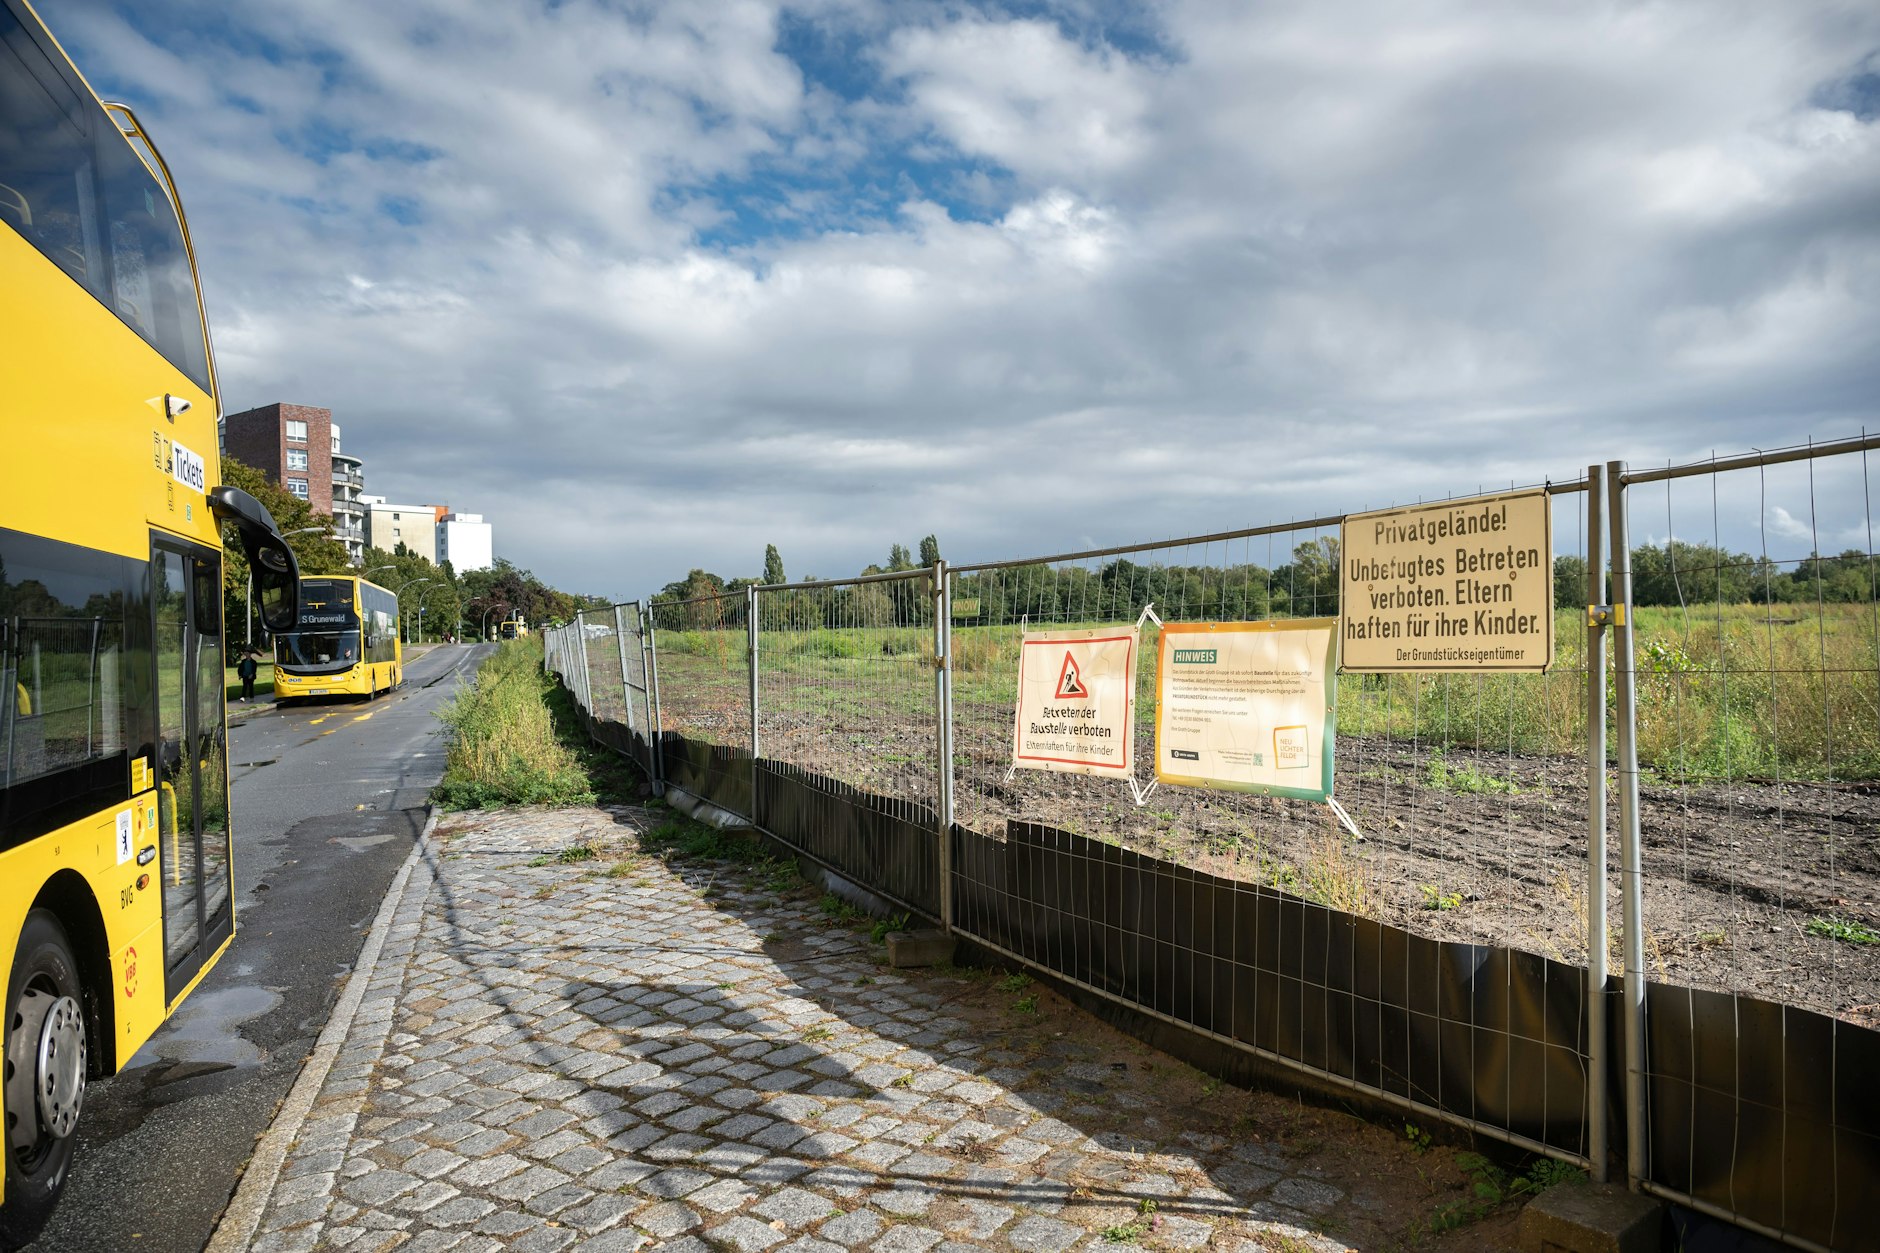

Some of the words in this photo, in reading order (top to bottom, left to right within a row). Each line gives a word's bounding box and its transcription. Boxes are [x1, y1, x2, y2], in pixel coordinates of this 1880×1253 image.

[174, 447, 203, 489] Tickets
[1375, 504, 1506, 545] Privatgelände!
[1350, 555, 1445, 584] Unbefugtes
[1456, 546, 1538, 574] Betreten
[1370, 585, 1450, 610] verboten.
[1456, 578, 1512, 604] Eltern
[302, 615, 307, 623] S
[309, 614, 345, 624] Grunewald
[1347, 616, 1400, 639] haften
[1407, 614, 1430, 637] für
[1435, 612, 1468, 636] ihre
[1474, 608, 1540, 636] Kinder.
[1176, 651, 1215, 662] HINWEIS
[1396, 649, 1412, 661] Der
[1412, 647, 1525, 663] Grundstückseigentümer
[1043, 706, 1080, 718] Betreten
[1081, 706, 1096, 719] der
[1030, 722, 1067, 734] Baustelle
[1069, 723, 1111, 738] verboten
[1066, 742, 1076, 752] für
[1076, 743, 1088, 753] ihre
[1090, 745, 1114, 756] Kinder
[120, 884, 133, 910] BVG
[126, 962, 136, 983] VBB
